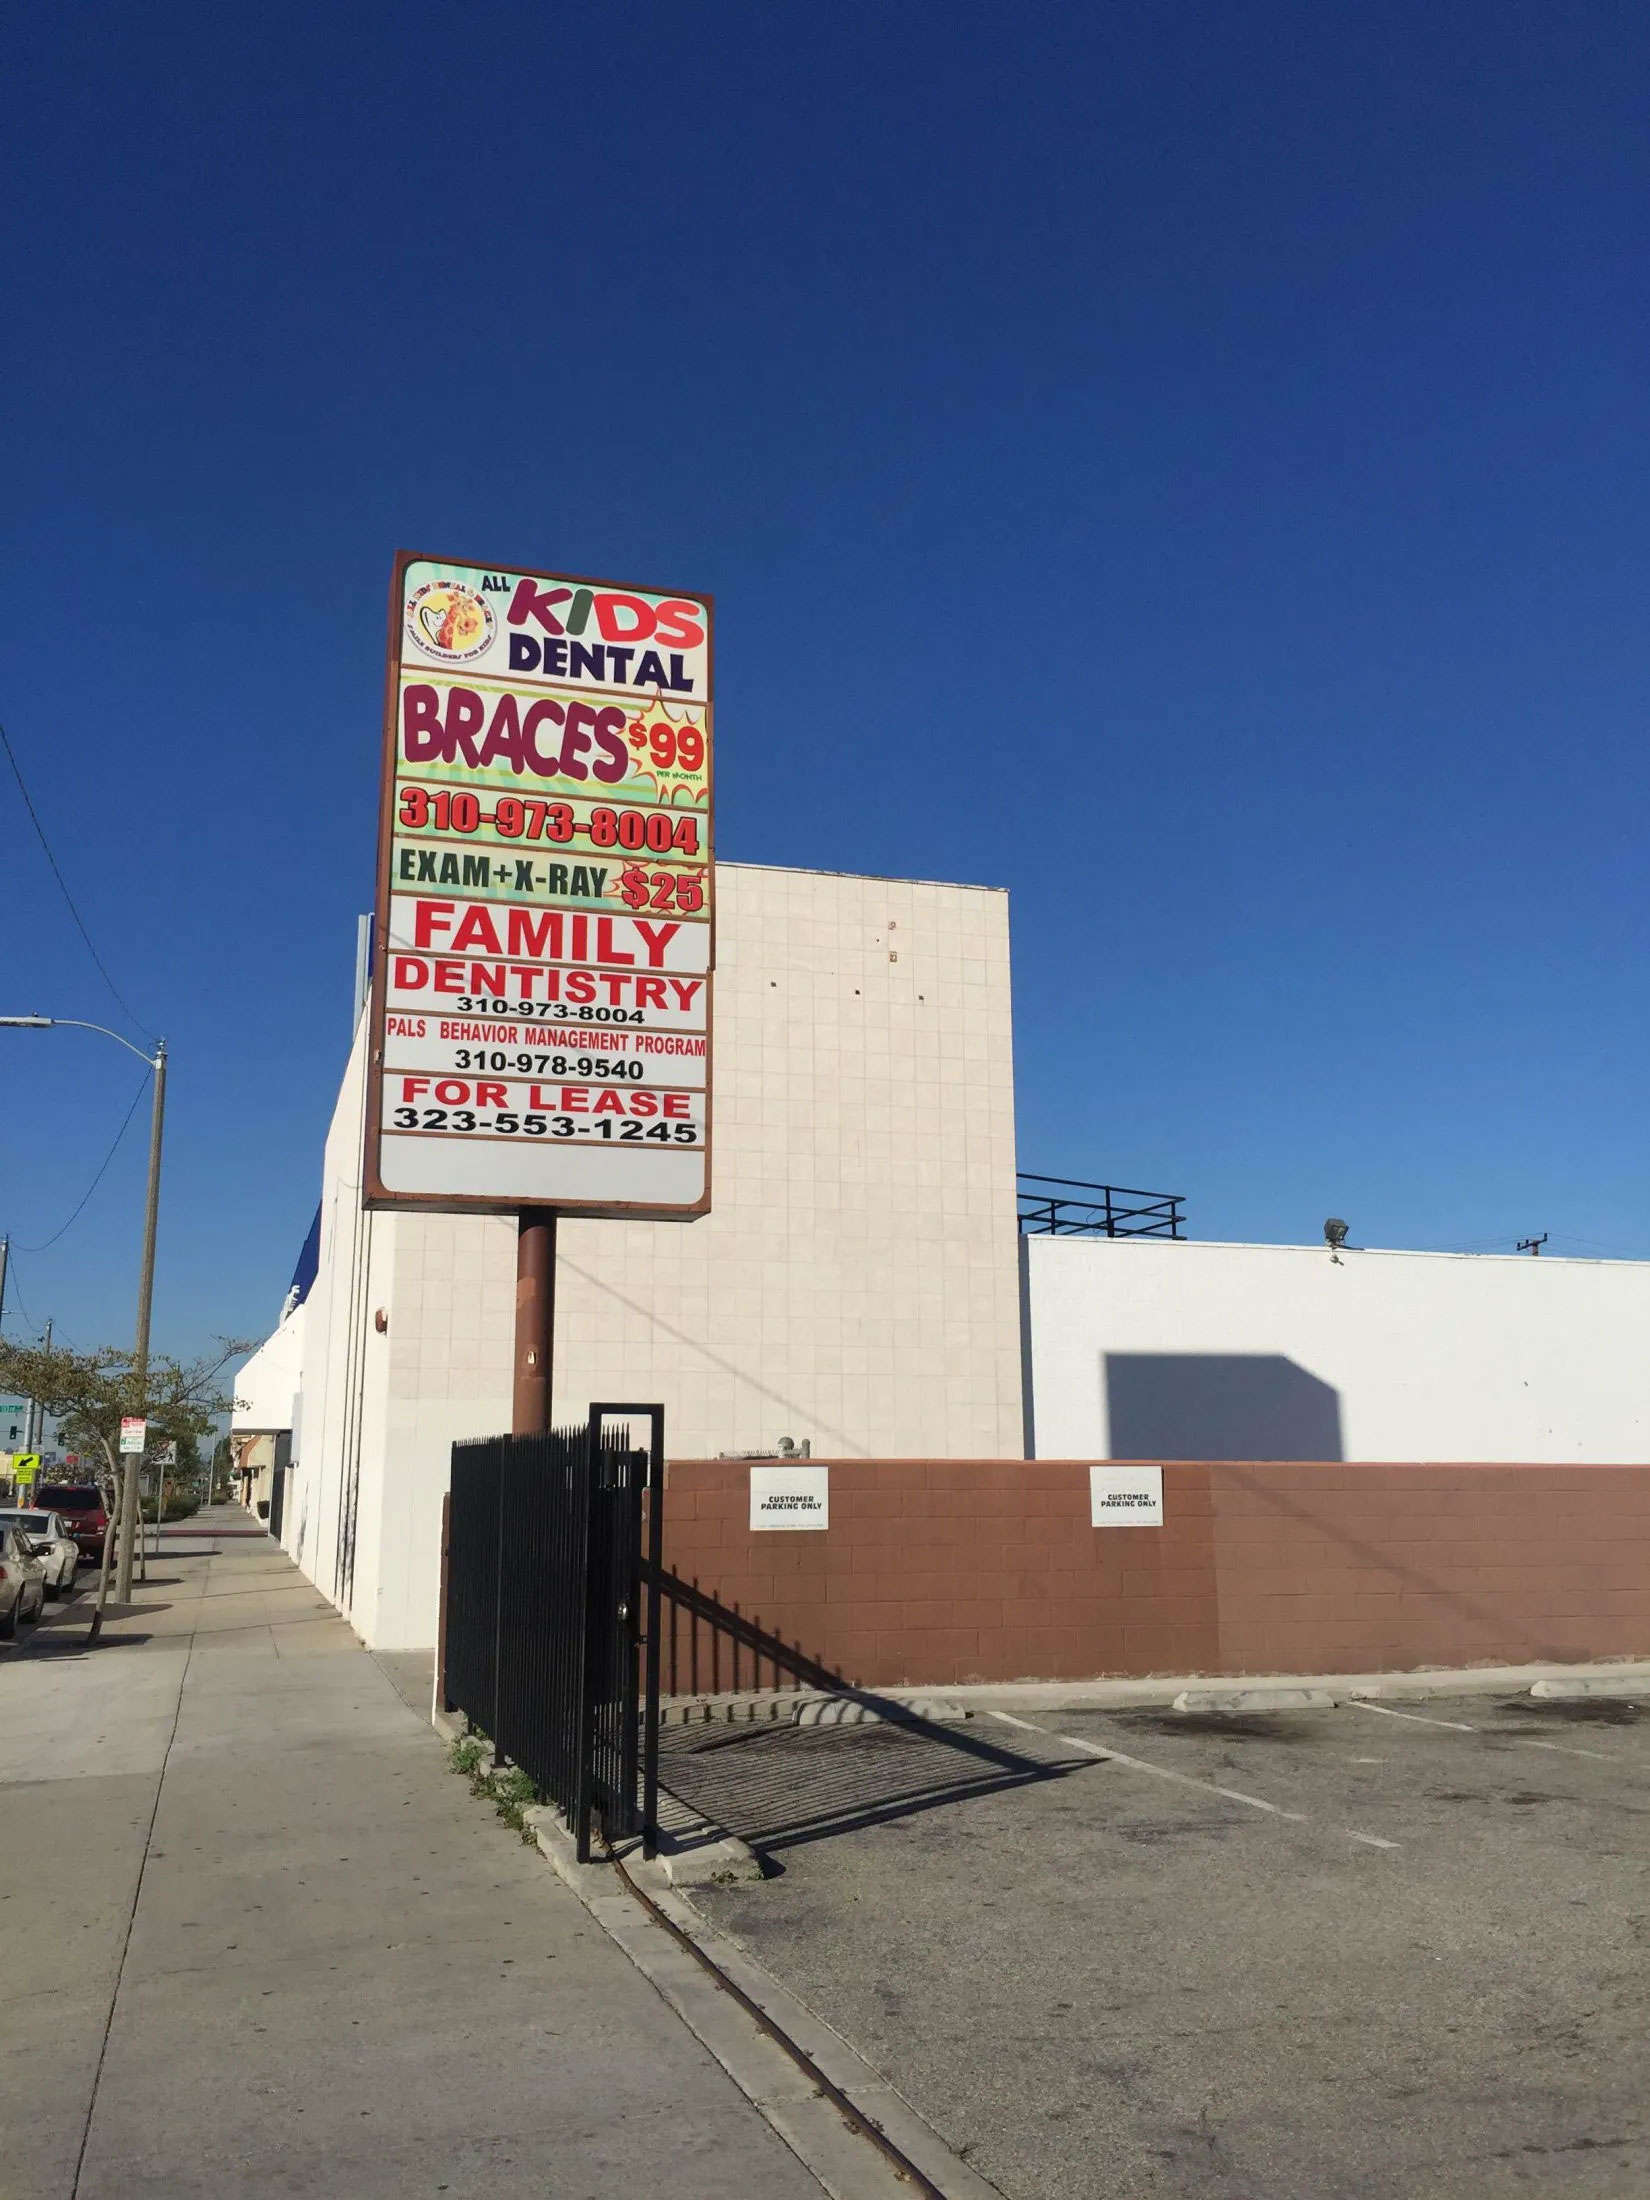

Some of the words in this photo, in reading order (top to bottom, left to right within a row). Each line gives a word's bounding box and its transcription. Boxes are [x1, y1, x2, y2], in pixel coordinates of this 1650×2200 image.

[481, 575, 511, 592] ALL
[506, 578, 705, 649] KIDS
[464, 650, 479, 659] FOR
[509, 632, 694, 692] DENTAL
[403, 684, 629, 783] BRACES
[629, 720, 704, 772] $99
[656, 770, 670, 778] PER
[673, 772, 703, 781] MONTH
[399, 786, 699, 856] 310-973-8004
[400, 848, 608, 898] EXAM+X-RAY
[621, 867, 704, 912] $25
[415, 900, 682, 968] FAMILY
[394, 957, 704, 1011] DENTISTRY
[457, 996, 645, 1024] 310-973-8004
[387, 1018, 426, 1038] PALS
[440, 1021, 518, 1044] BEHAVIOR
[525, 1027, 629, 1052] MANAGEMENT
[635, 1035, 706, 1057] PROGRAM
[455, 1049, 644, 1080] 310-978-9540
[402, 1077, 510, 1109] FOR
[529, 1085, 691, 1119] LEASE
[393, 1107, 697, 1143] 323-553-1245
